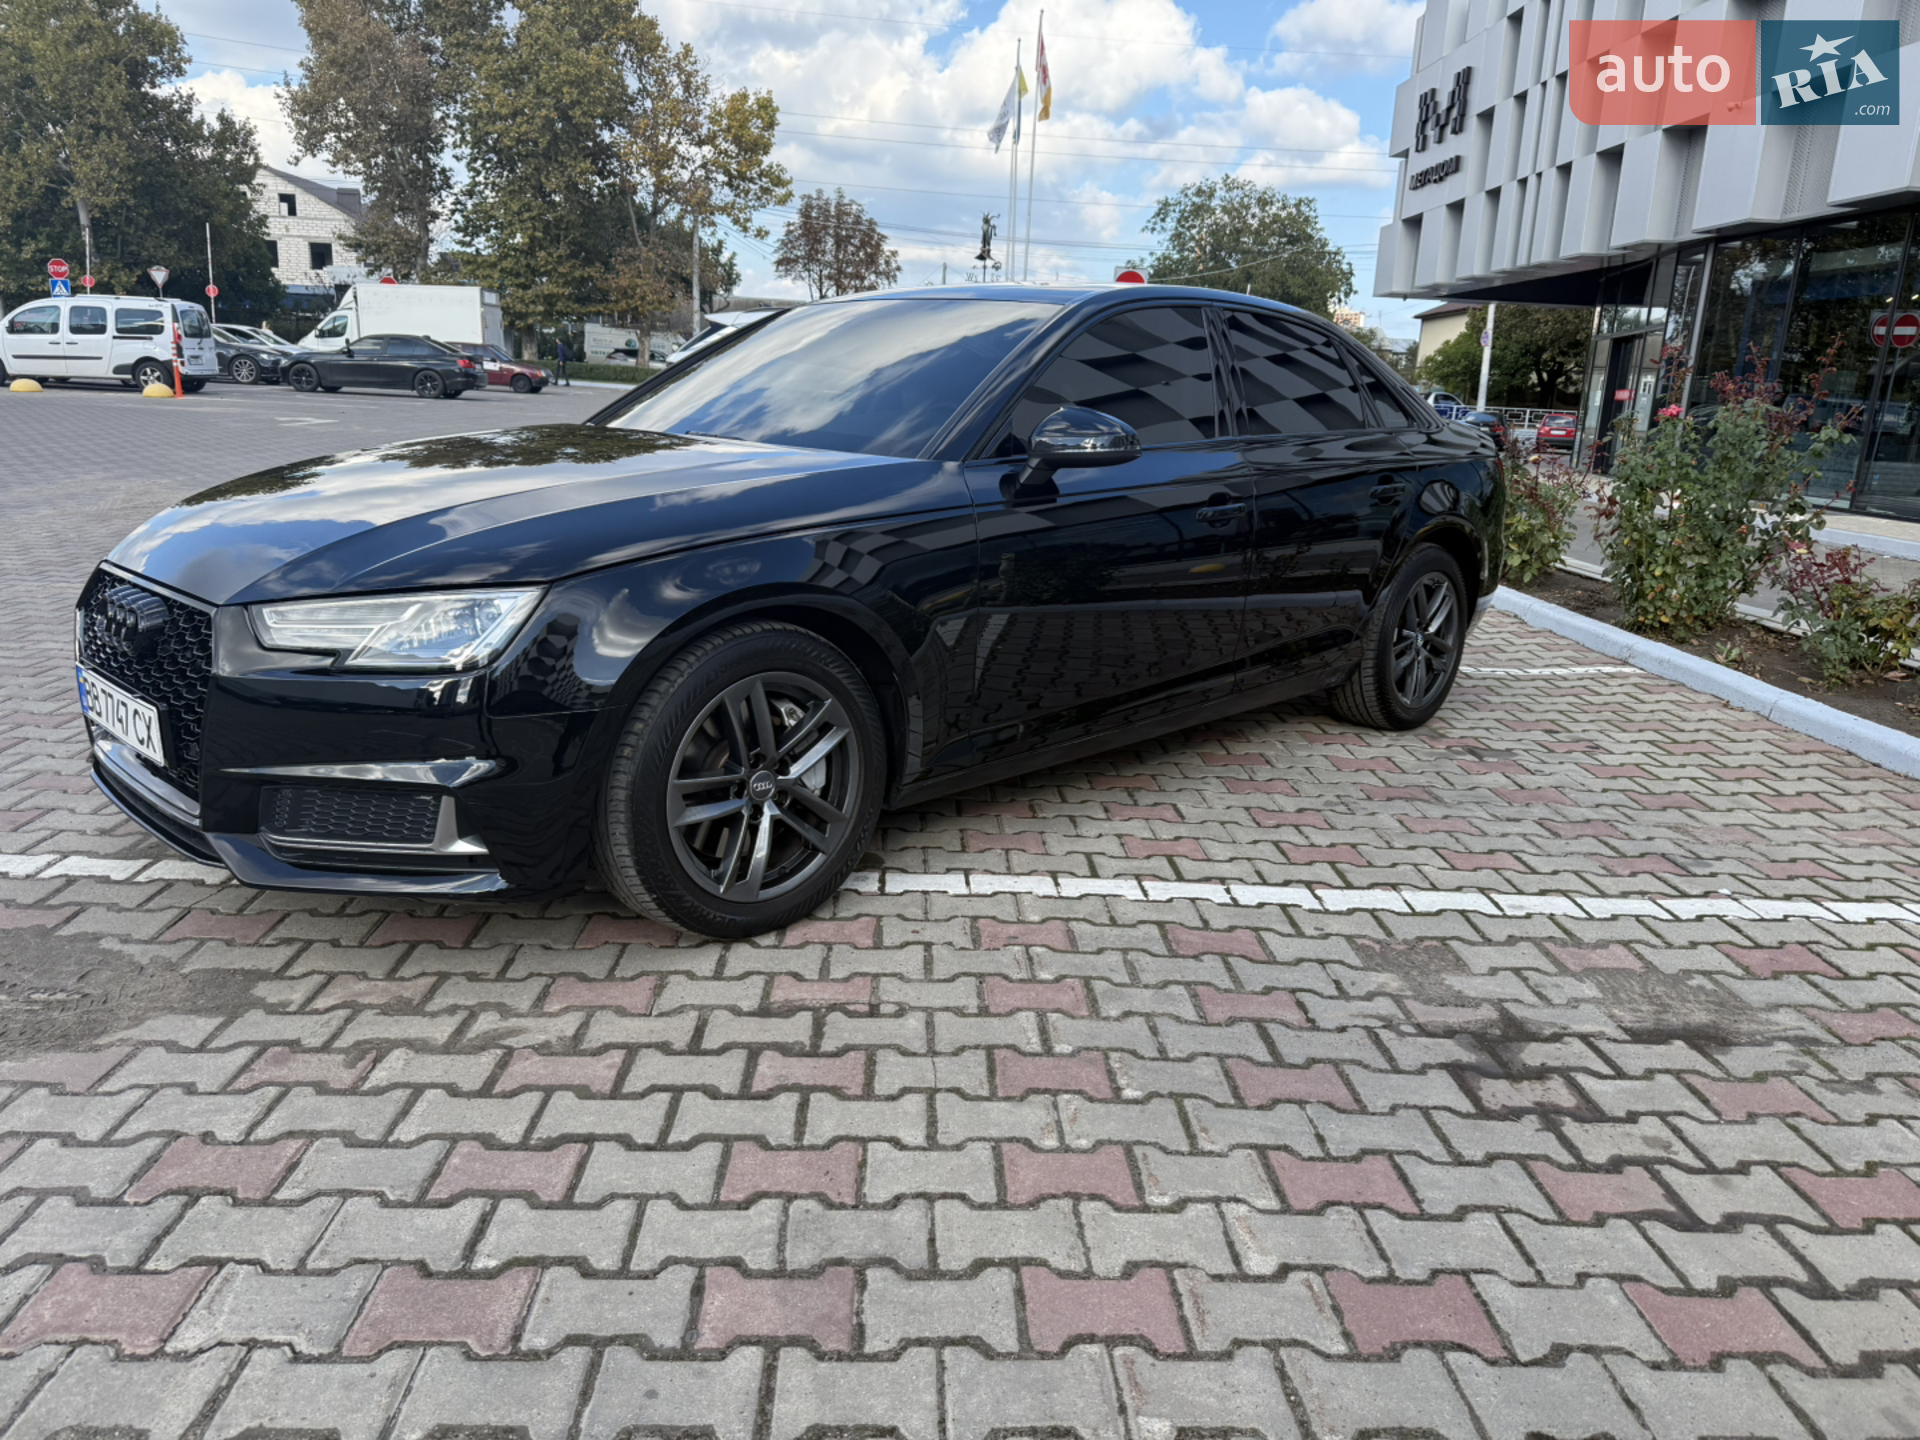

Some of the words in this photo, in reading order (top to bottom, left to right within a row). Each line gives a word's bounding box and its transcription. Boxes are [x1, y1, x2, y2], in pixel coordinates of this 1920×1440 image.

[1409, 155, 1461, 190] МЕГАДОМ
[48, 264, 69, 273] STOP
[101, 687, 128, 737] 7747
[132, 708, 157, 754] CX
